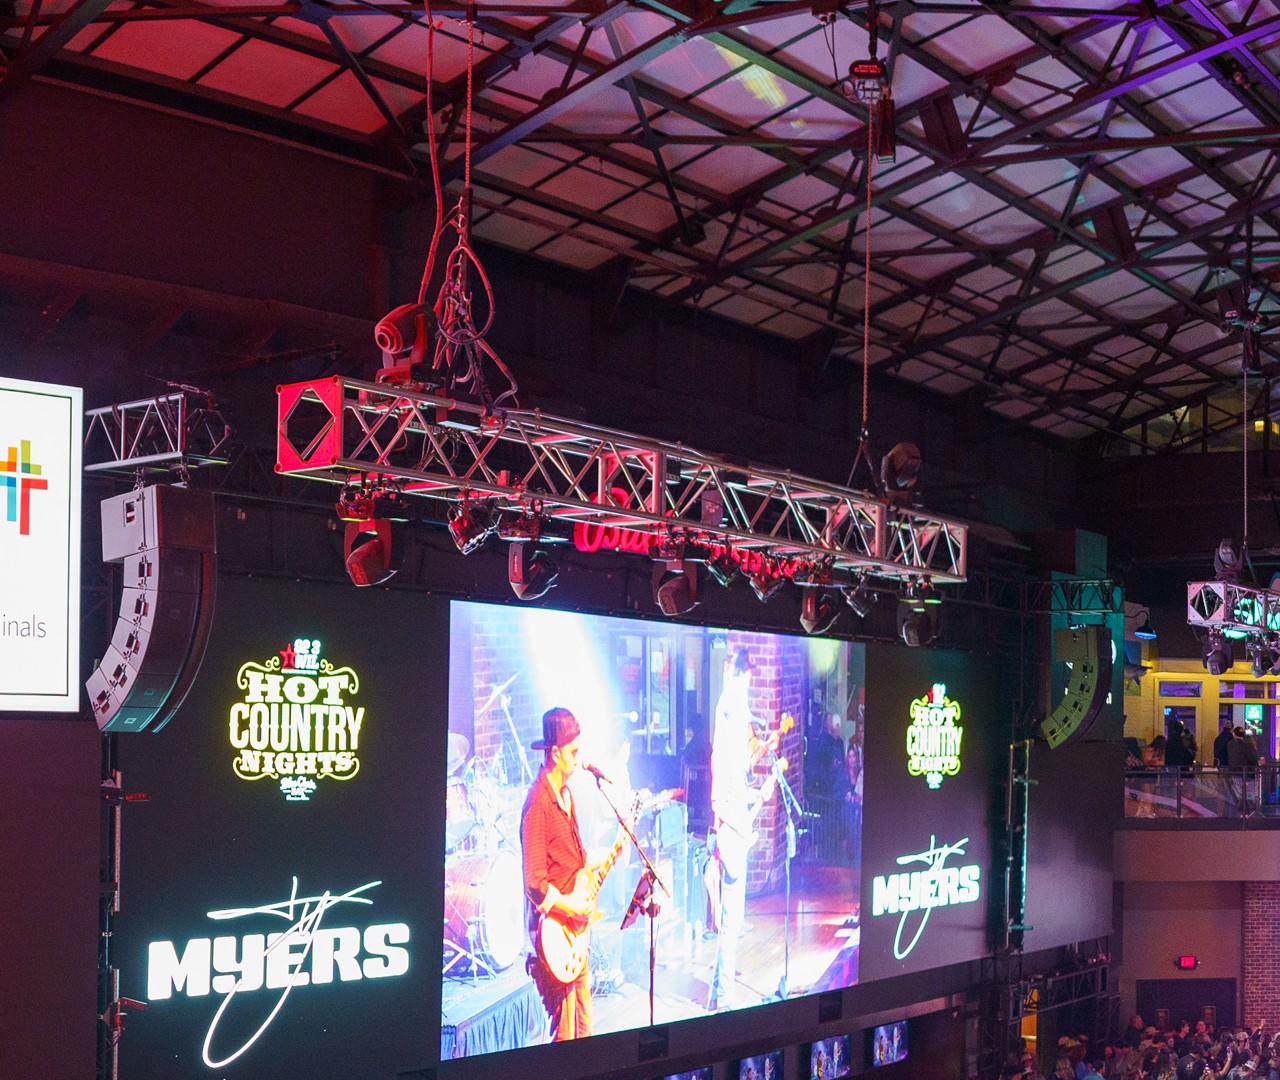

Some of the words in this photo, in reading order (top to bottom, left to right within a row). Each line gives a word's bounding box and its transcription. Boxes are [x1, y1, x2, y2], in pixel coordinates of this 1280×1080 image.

[245, 670, 349, 705] HOT
[229, 703, 365, 751] COUNTRY
[914, 706, 957, 726] HOT
[907, 725, 963, 756] COUNTRY
[240, 750, 356, 775] NIGHTS
[873, 864, 980, 917] MYERS
[148, 922, 410, 1001] MYERS
